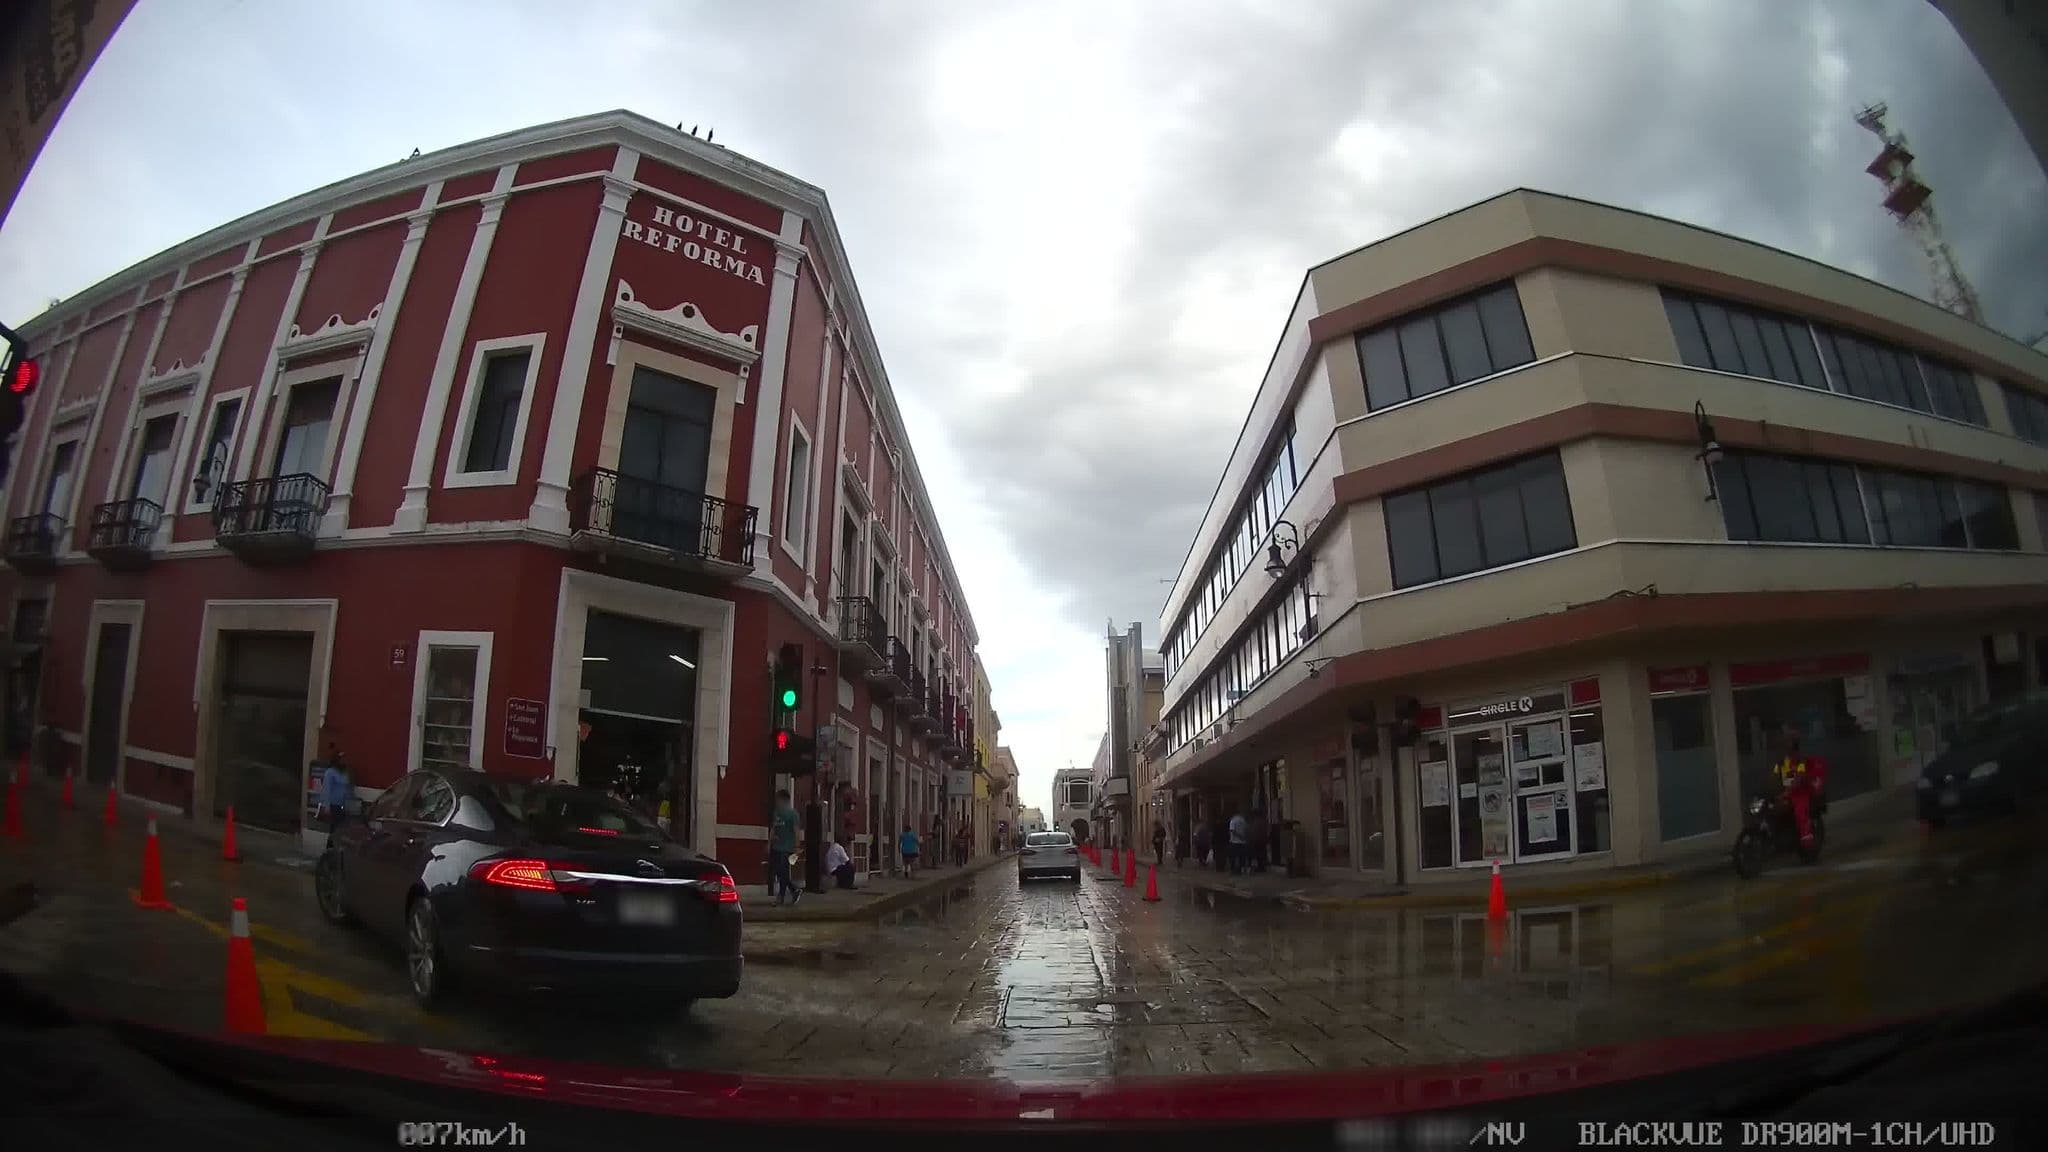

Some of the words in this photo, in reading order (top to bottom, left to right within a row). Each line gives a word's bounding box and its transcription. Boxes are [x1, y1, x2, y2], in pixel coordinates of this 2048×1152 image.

[622, 219, 766, 286] REFORMA
[652, 206, 747, 254] HOTEL
[1480, 701, 1517, 716] CIRCLE
